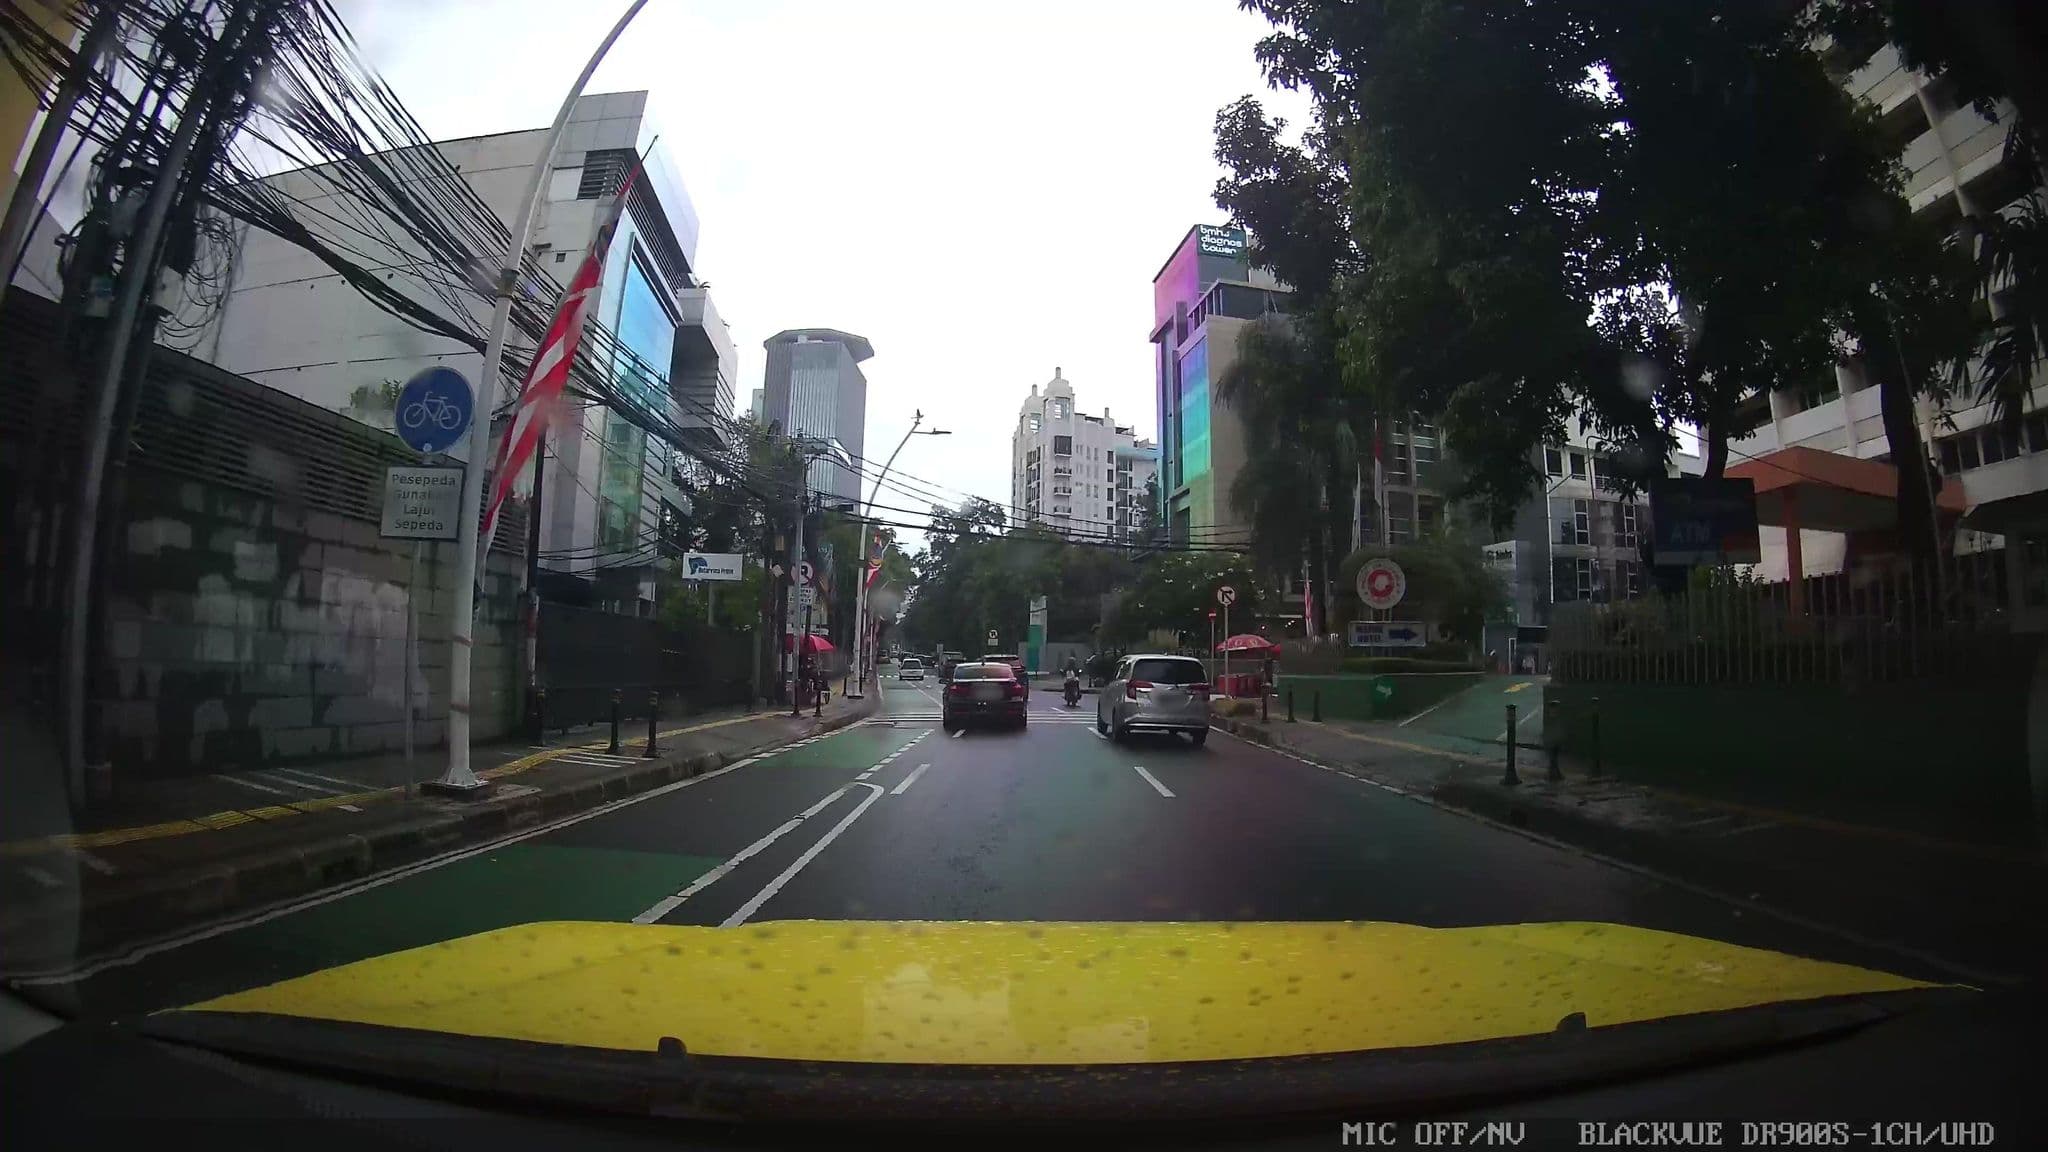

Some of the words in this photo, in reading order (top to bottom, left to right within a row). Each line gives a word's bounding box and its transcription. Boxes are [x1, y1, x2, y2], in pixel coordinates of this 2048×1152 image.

[1202, 242, 1237, 254] tower
[392, 474, 456, 486] Pesepeda
[394, 519, 443, 532] Sepeda
